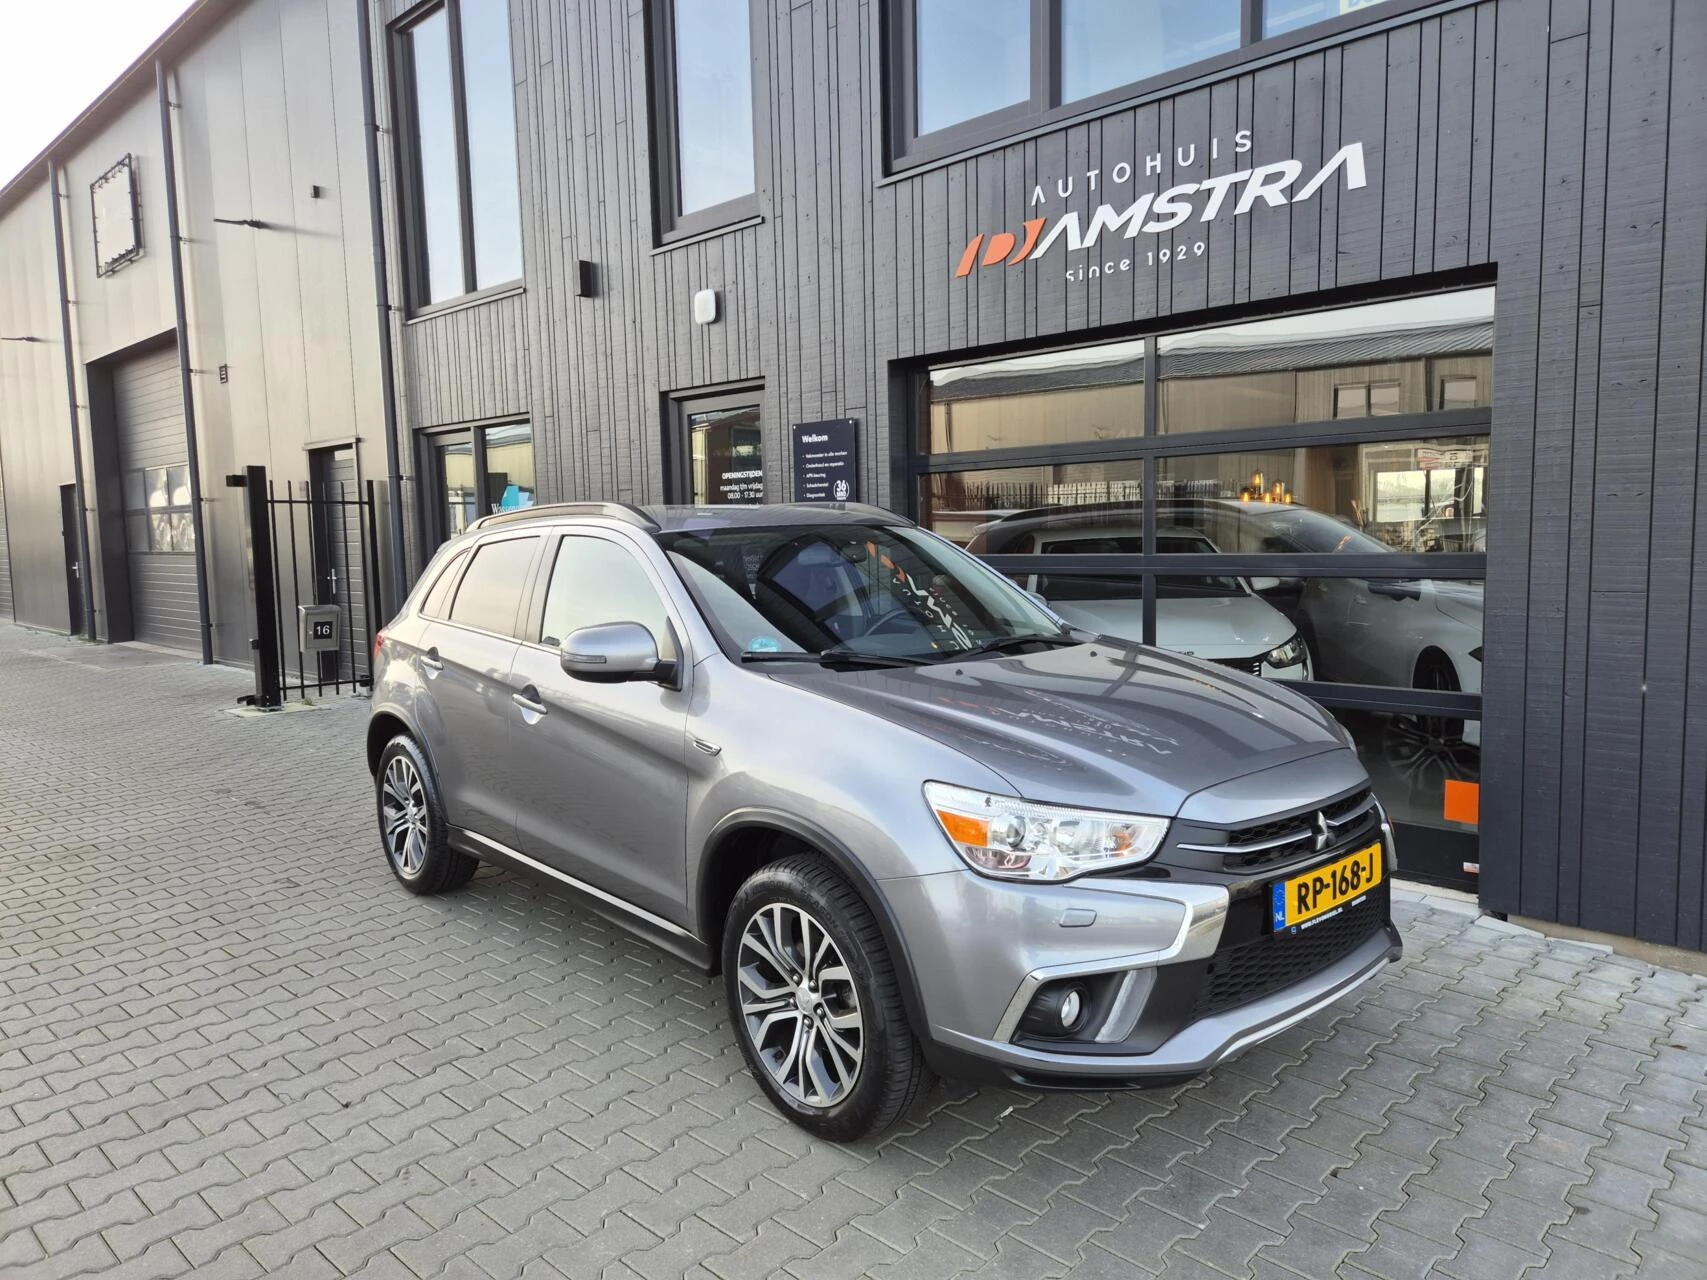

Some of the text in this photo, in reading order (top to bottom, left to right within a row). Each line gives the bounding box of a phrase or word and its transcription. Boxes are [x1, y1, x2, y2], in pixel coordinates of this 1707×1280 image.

[1030, 129, 1253, 206] AUTOHUIS
[1065, 241, 1206, 282] since 1929
[802, 433, 829, 443] Welkom
[721, 470, 762, 479] OPENINGSTIJDEN
[836, 480, 846, 491] 36
[316, 625, 330, 636] 16
[1297, 852, 1374, 915] RP-168-J
[1274, 911, 1285, 922] NL
